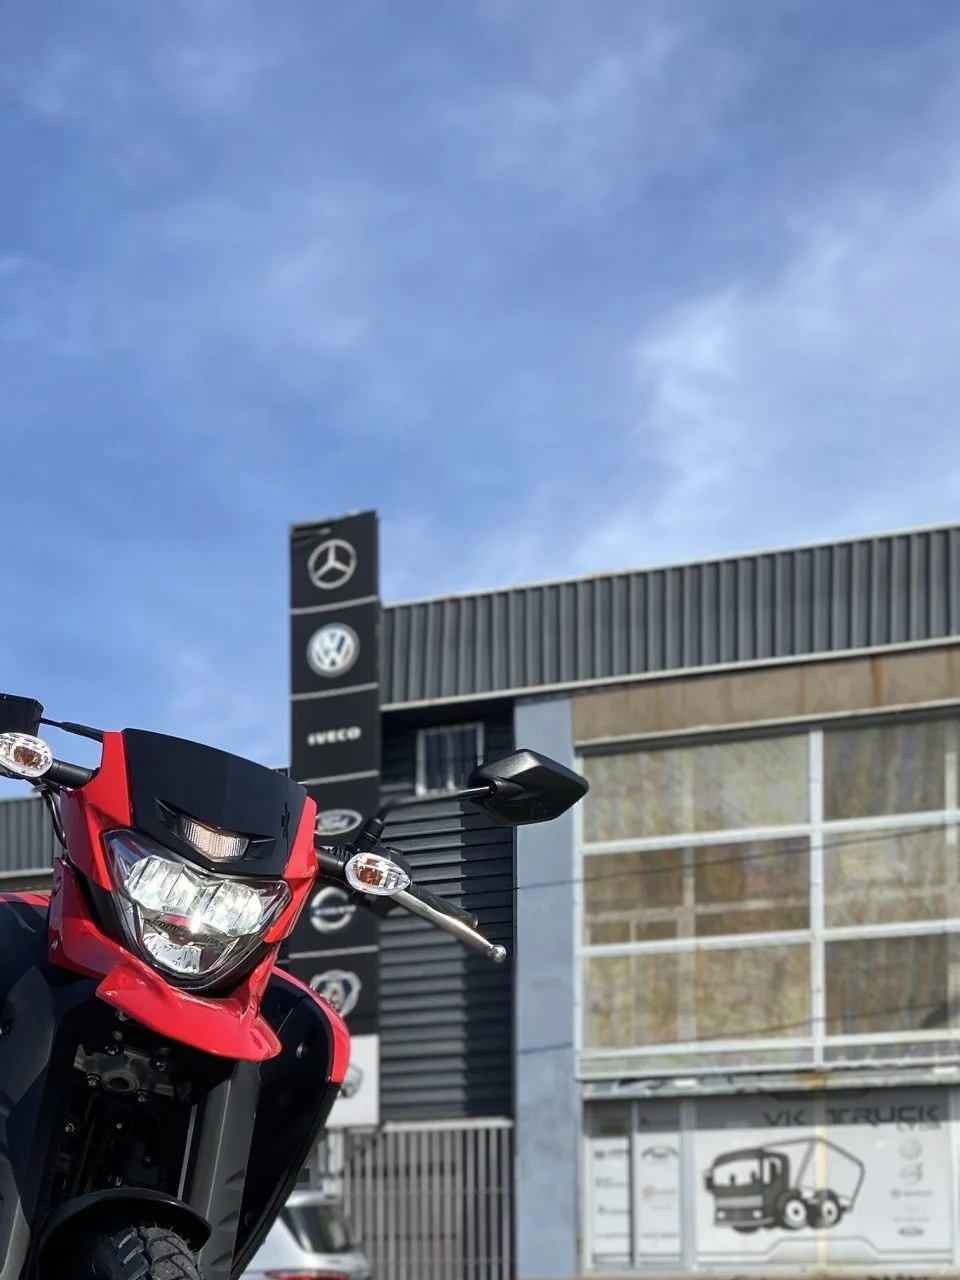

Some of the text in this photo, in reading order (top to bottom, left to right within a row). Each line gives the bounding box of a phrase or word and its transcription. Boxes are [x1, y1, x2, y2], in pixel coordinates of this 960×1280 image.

[306, 726, 361, 746] IVECO
[762, 1109, 808, 1127] VK
[825, 1105, 941, 1129] TRUCK
